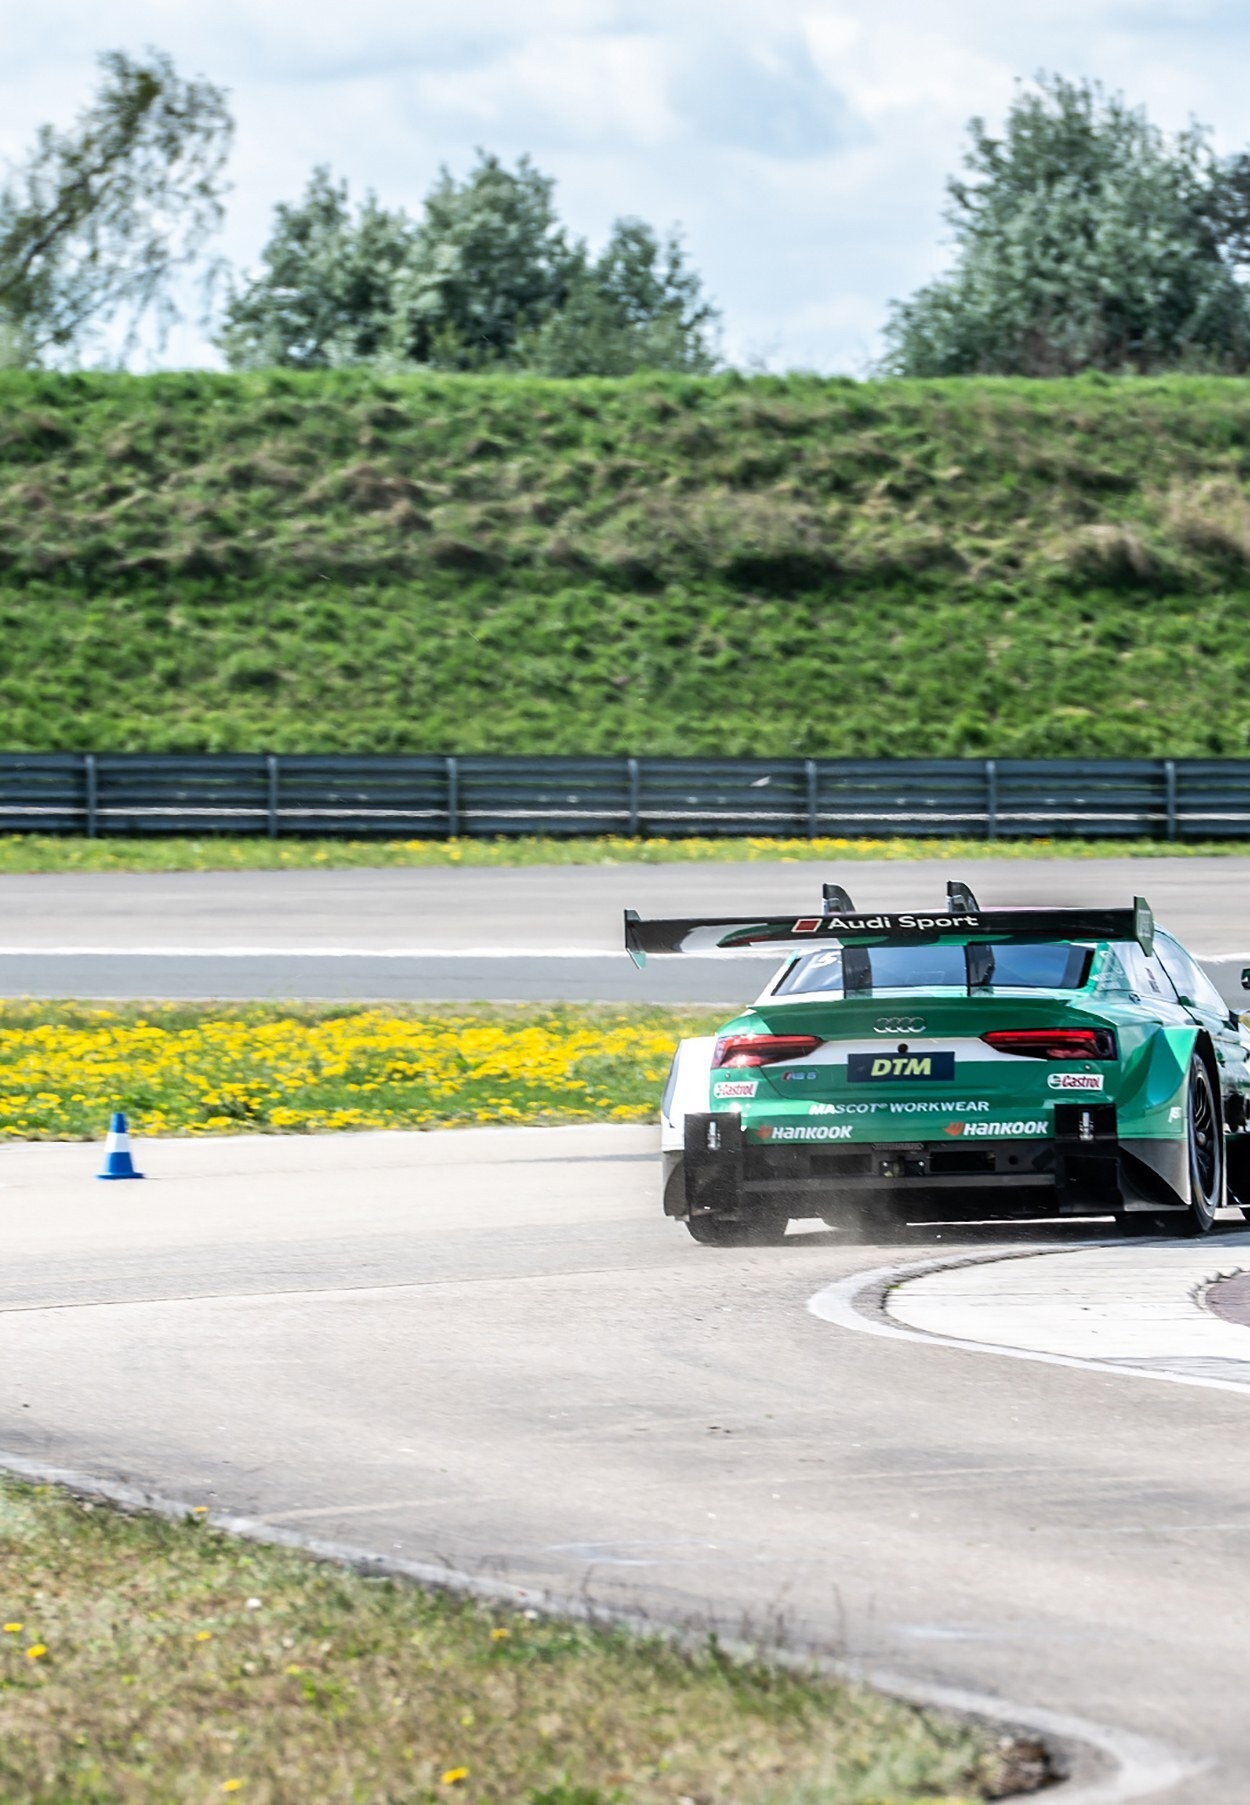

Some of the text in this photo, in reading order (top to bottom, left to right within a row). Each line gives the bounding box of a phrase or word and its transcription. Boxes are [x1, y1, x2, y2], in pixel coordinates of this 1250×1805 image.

[827, 915, 980, 930] Audi Sport
[871, 1057, 932, 1077] DTM
[1062, 1075, 1101, 1089] Castrol
[890, 1101, 990, 1113] WORKWEAR
